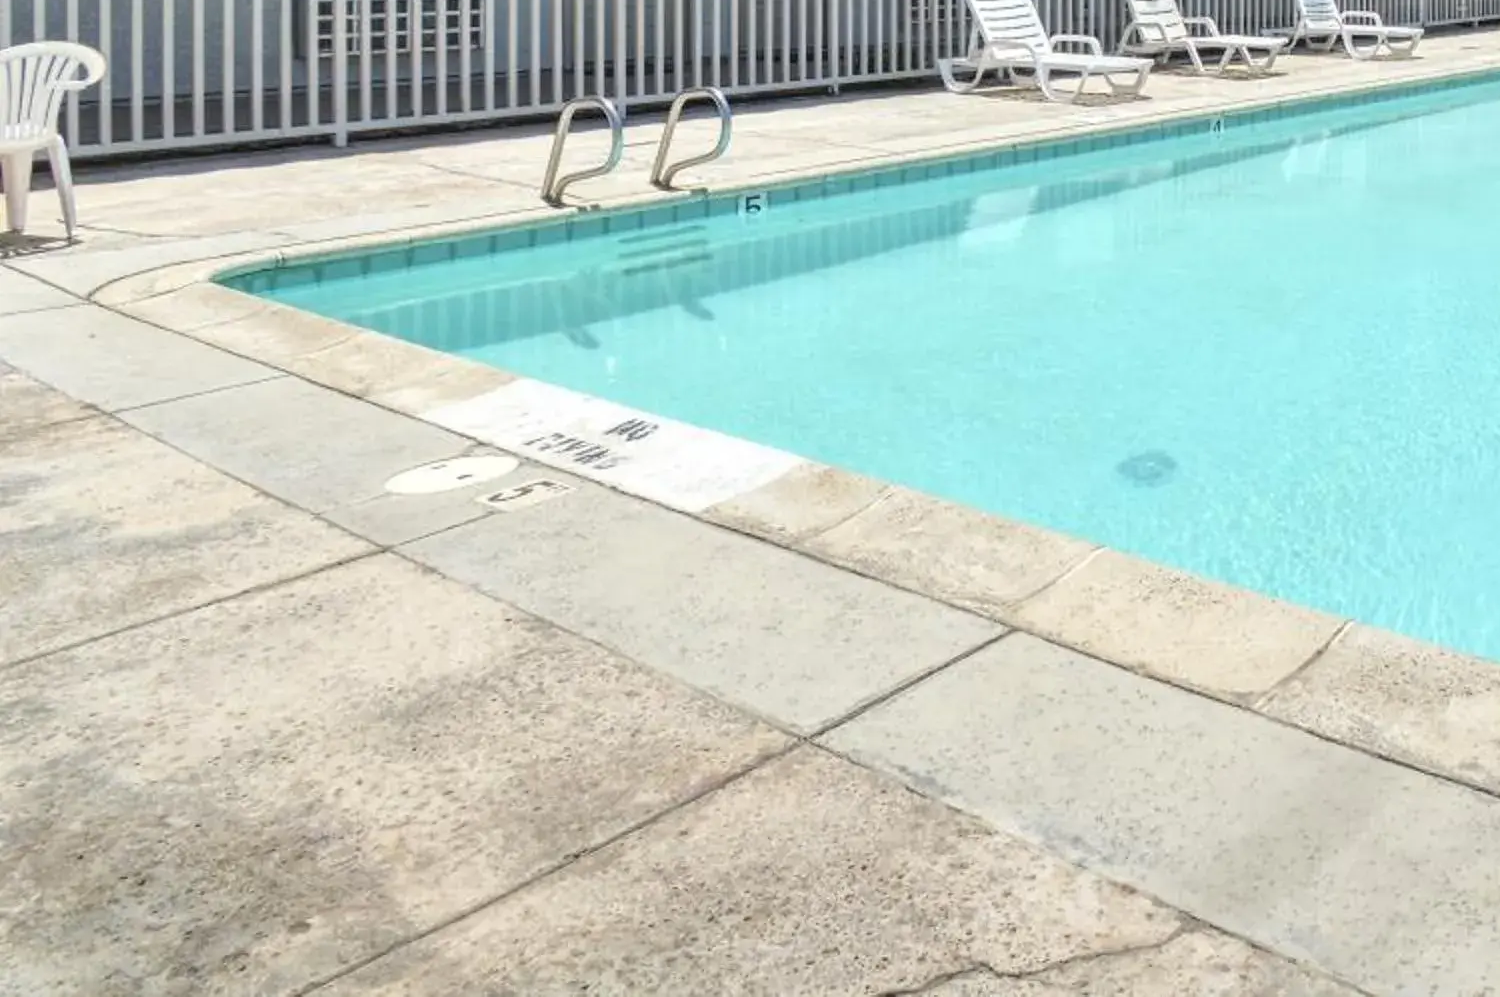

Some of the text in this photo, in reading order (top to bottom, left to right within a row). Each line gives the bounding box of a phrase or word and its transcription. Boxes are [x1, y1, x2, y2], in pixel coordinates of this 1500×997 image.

[745, 194, 761, 213] 5
[604, 418, 660, 443] NO
[487, 481, 558, 502] 5
